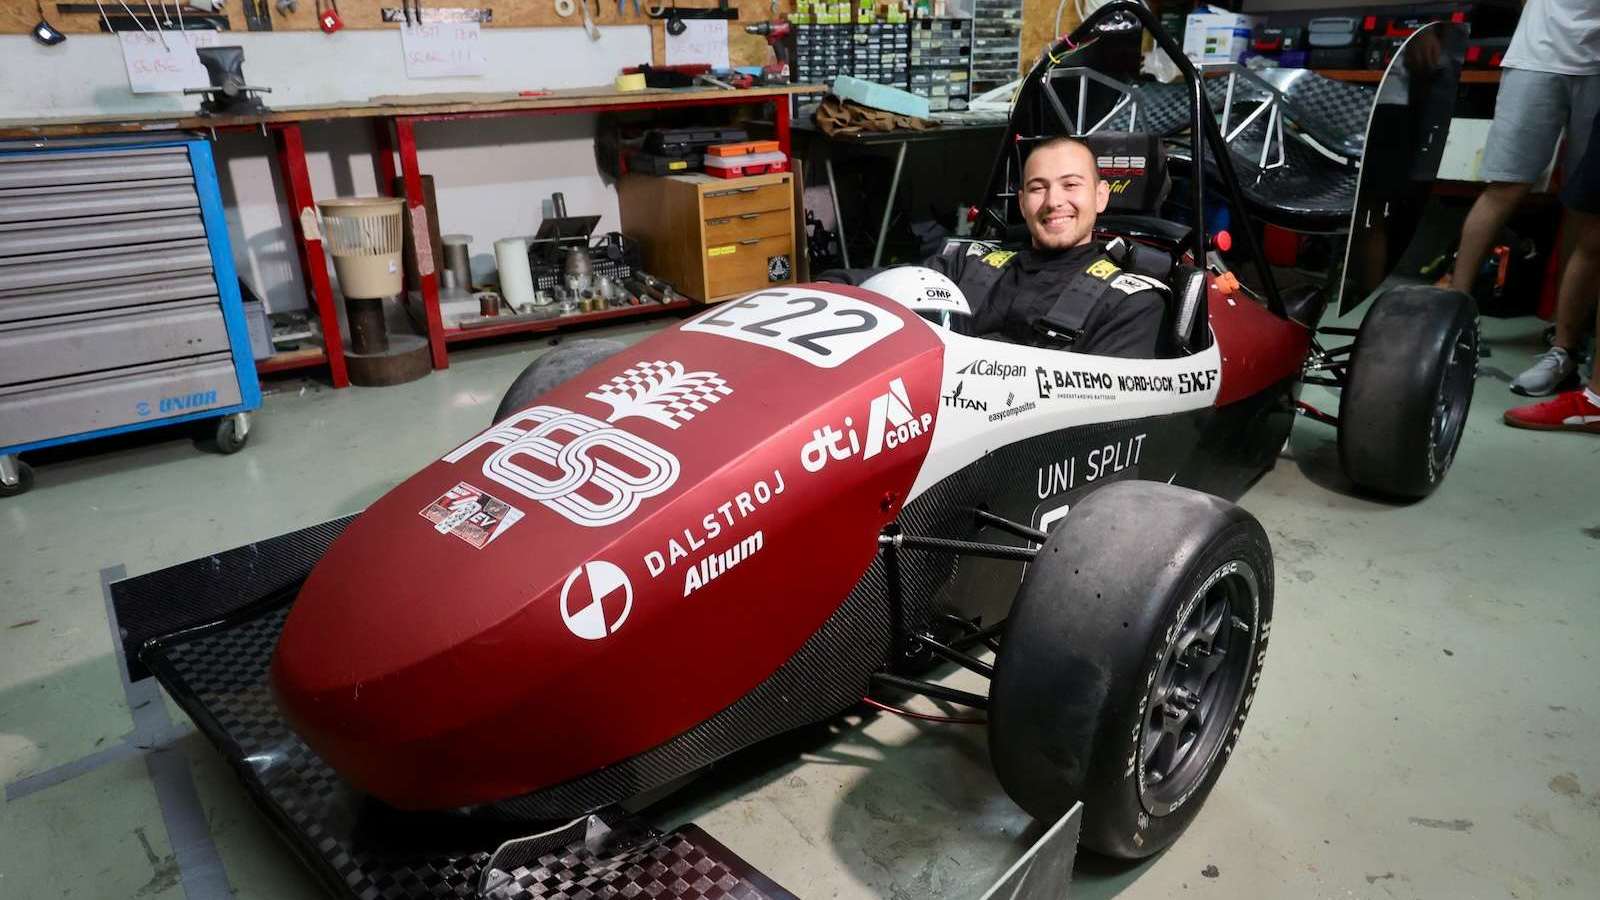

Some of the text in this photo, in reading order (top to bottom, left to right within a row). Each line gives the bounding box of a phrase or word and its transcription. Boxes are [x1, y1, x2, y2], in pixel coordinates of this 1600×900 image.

[1096, 156, 1146, 169] ESB
[926, 289, 951, 299] OMP
[698, 291, 879, 356] E22
[976, 359, 1027, 380] Calspan
[1053, 370, 1113, 390] BATEMO
[1117, 375, 1174, 392] NORD-LOCK
[1178, 369, 1219, 395] SKF
[159, 388, 217, 413] UNIOR
[942, 390, 988, 412] TITAN
[988, 401, 1036, 422] easycomposites
[800, 416, 860, 473] dti
[1038, 433, 1146, 499] UNI SPLIT
[643, 469, 785, 579] DALSTROJ
[683, 529, 764, 598] Altium
